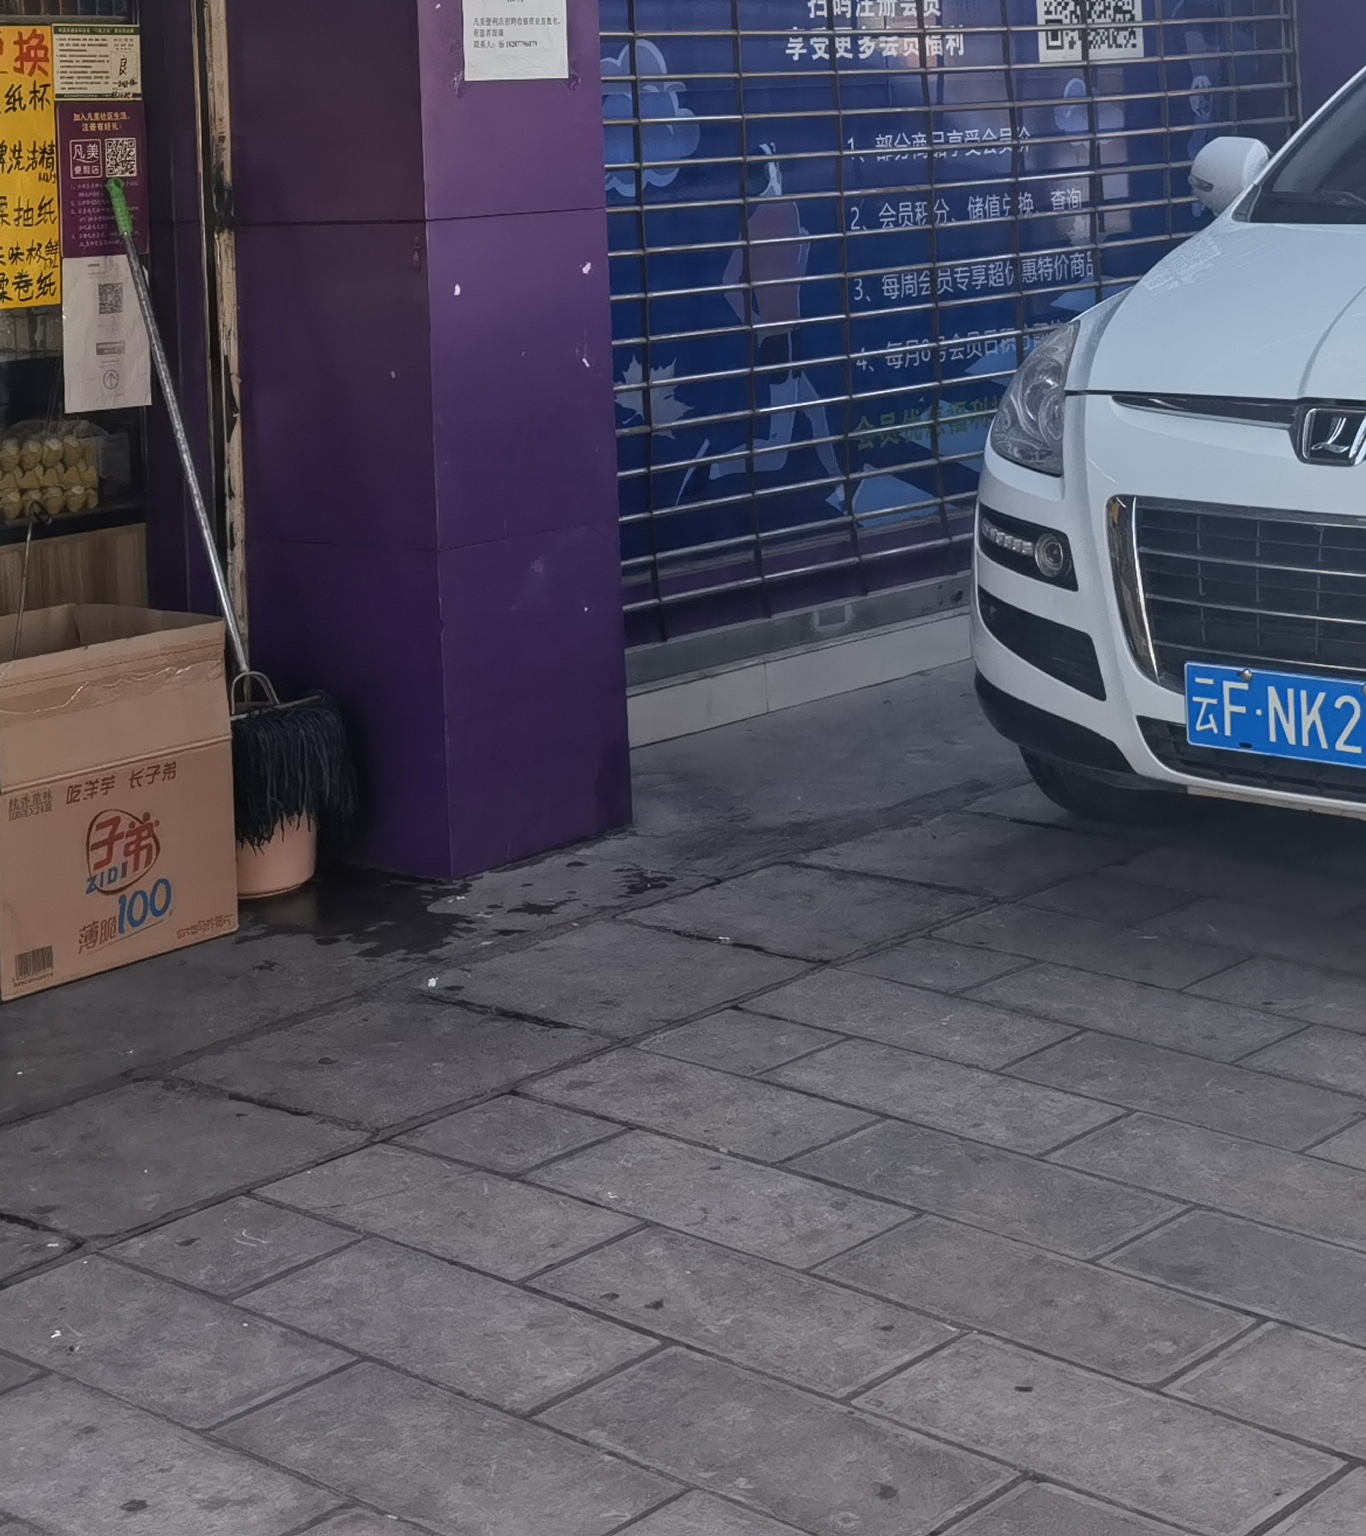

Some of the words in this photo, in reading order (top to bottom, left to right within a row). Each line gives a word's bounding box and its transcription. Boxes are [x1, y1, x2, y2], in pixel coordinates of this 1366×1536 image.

[73, 143, 99, 160] 凡美
[66, 774, 116, 805] 吃洋芋
[129, 761, 177, 789] 长子弟
[90, 812, 155, 874] 子弟
[86, 861, 128, 895] ZIDI
[117, 878, 172, 934] 100
